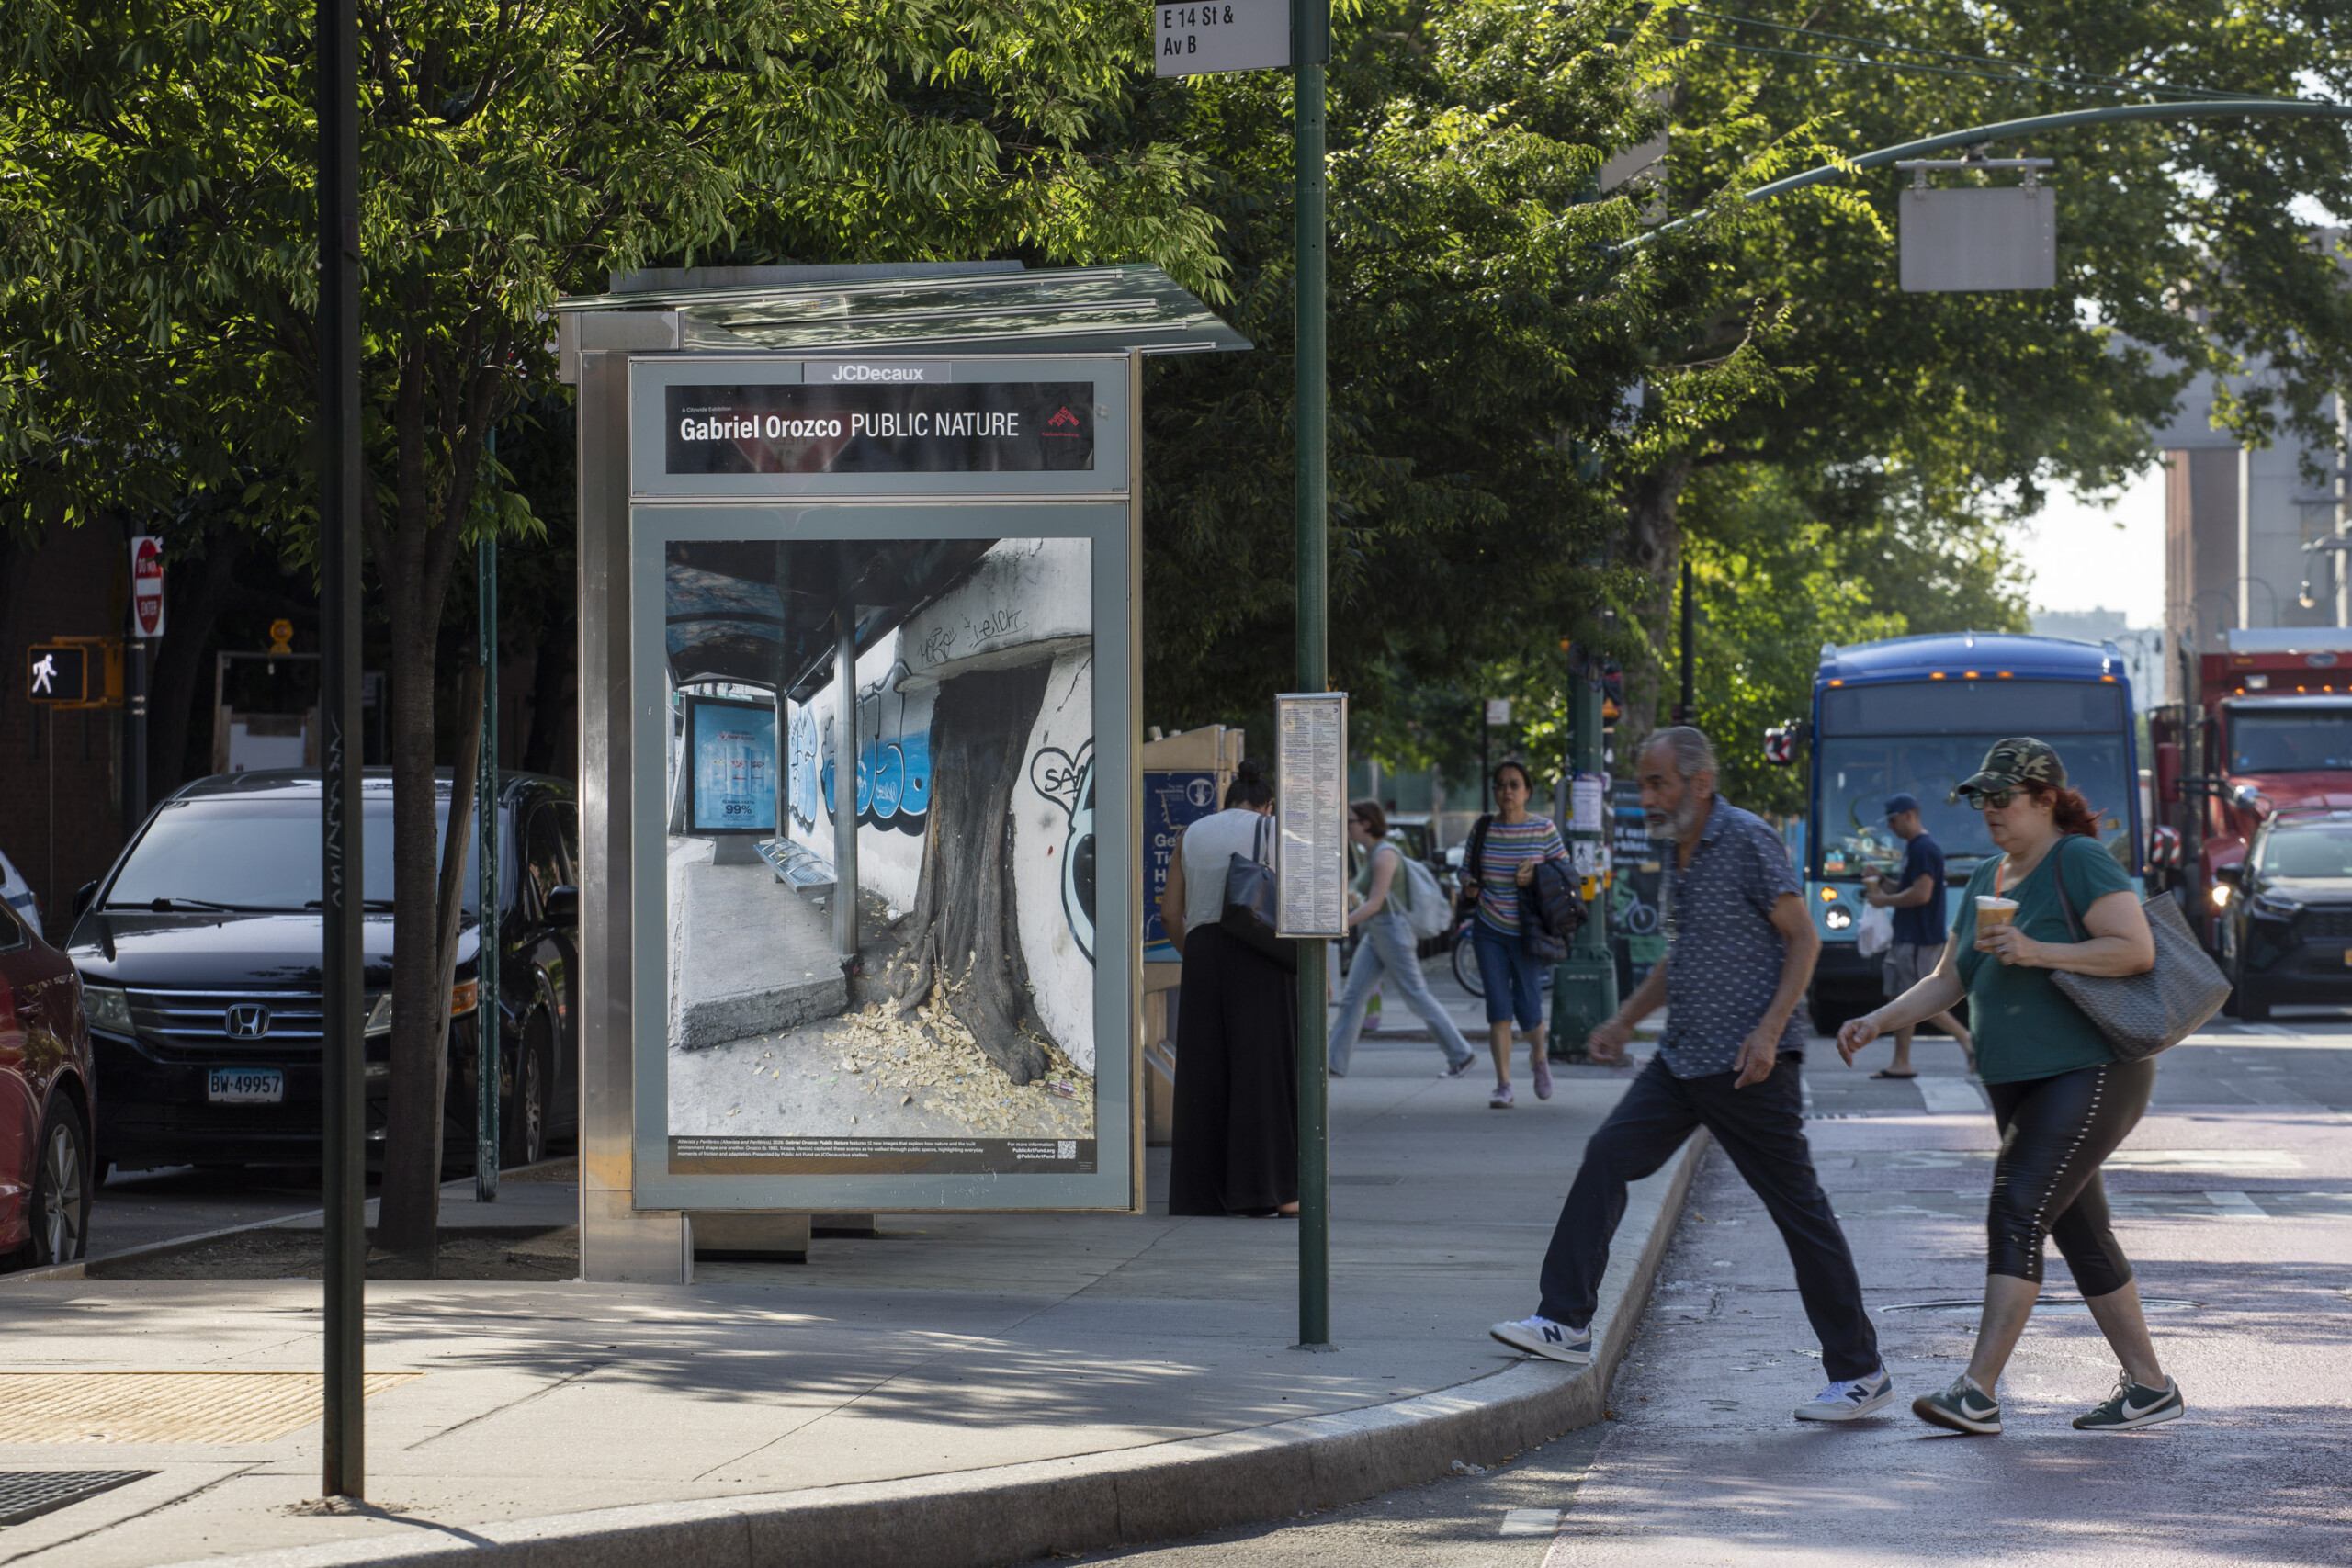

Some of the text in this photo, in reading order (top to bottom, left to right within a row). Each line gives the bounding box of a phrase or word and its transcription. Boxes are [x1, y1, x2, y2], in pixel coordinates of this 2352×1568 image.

[1164, 5, 1234, 28] E 14 St &
[1163, 35, 1197, 56] Av B
[832, 365, 924, 381] JCDecaux
[680, 412, 1019, 441] Gabriel Orozco PUBLIC NATURE
[726, 804, 752, 815] 99%
[1154, 832, 1179, 848] Ge
[1542, 1325, 1562, 1343] N
[1845, 1383, 1870, 1404] N
